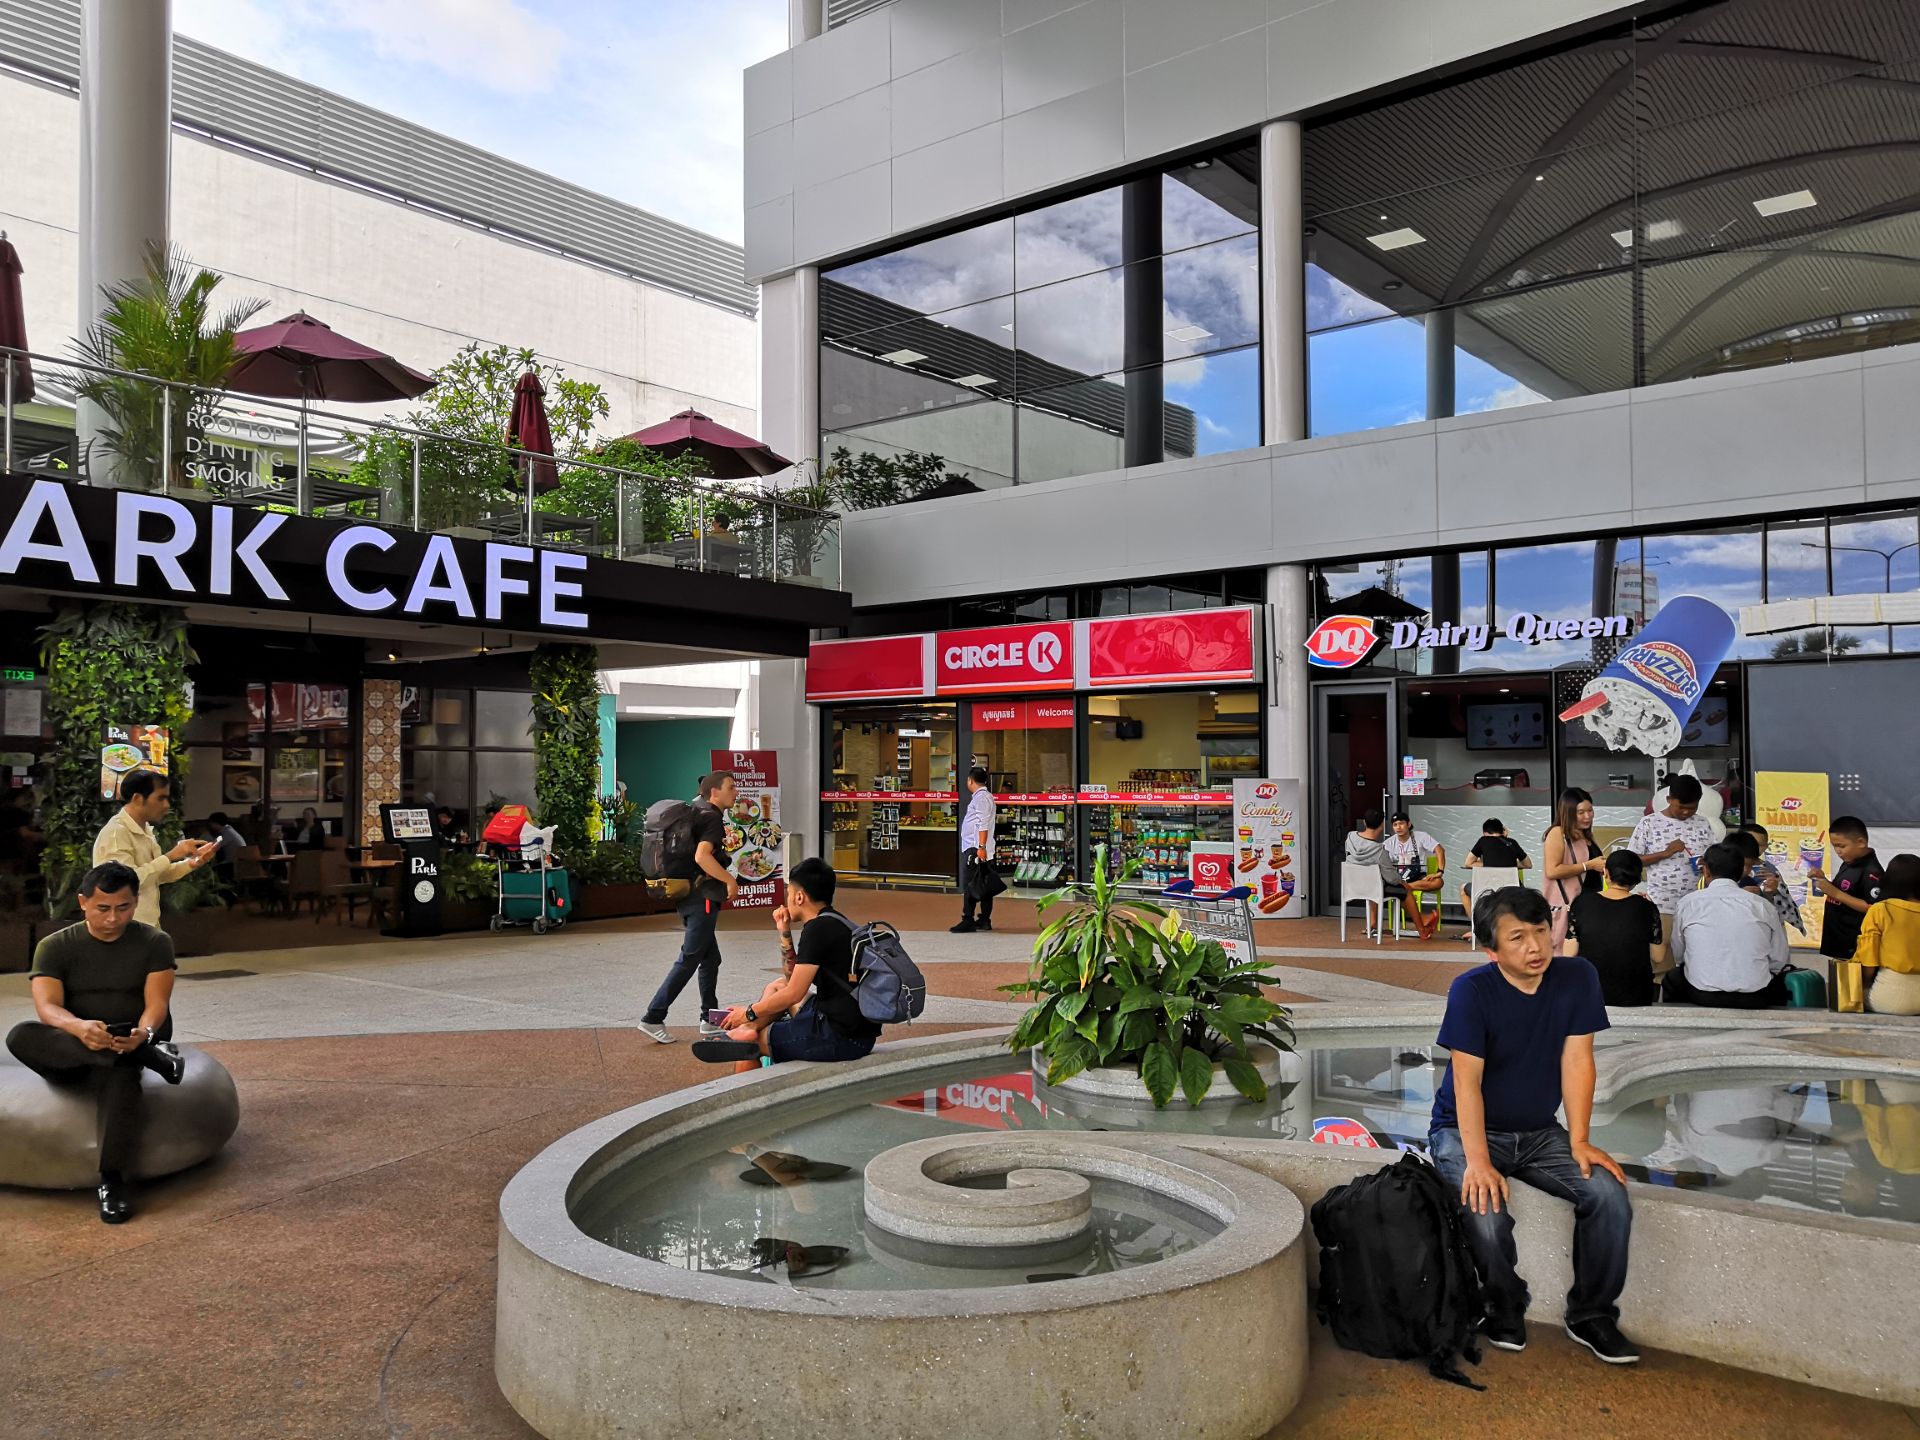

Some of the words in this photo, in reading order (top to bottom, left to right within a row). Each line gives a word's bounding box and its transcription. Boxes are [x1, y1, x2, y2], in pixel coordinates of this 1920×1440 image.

[186, 411, 285, 442] ROOFTOP
[186, 436, 285, 468] DINING
[185, 462, 284, 492] SMOKING
[325, 525, 590, 629] CAFE
[1317, 626, 1368, 656] DQ
[1389, 621, 1491, 651] Dairy
[1504, 611, 1629, 645] Queen
[944, 642, 1024, 670] CIRCLE
[1620, 646, 1699, 700] BLIZZARD
[1037, 708, 1074, 717] Welcome
[1259, 786, 1275, 795] DQ
[1240, 801, 1284, 818] Combo
[732, 897, 773, 907] WELCOME
